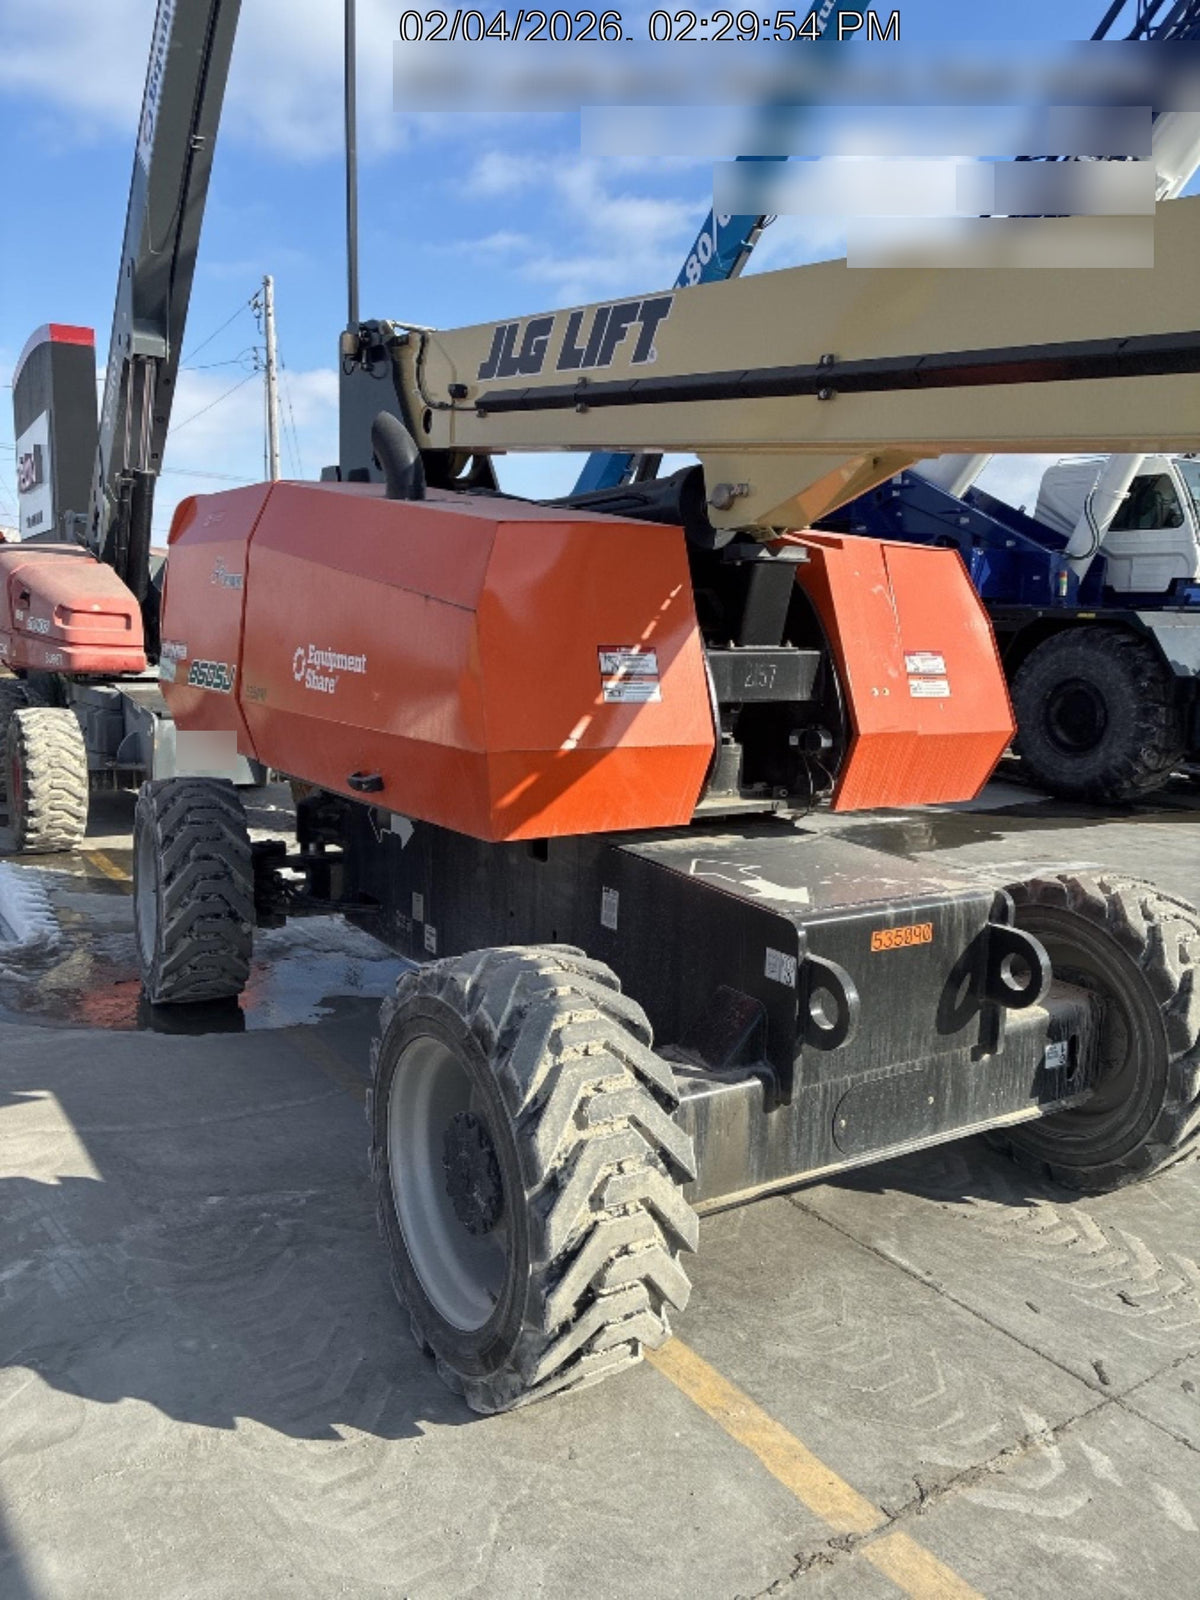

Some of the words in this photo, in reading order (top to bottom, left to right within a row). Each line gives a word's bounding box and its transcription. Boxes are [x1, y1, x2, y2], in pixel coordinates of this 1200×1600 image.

[477, 314, 556, 383] JLG
[554, 294, 675, 373] LIFT
[307, 644, 367, 674] Equipment
[305, 668, 336, 694] Share
